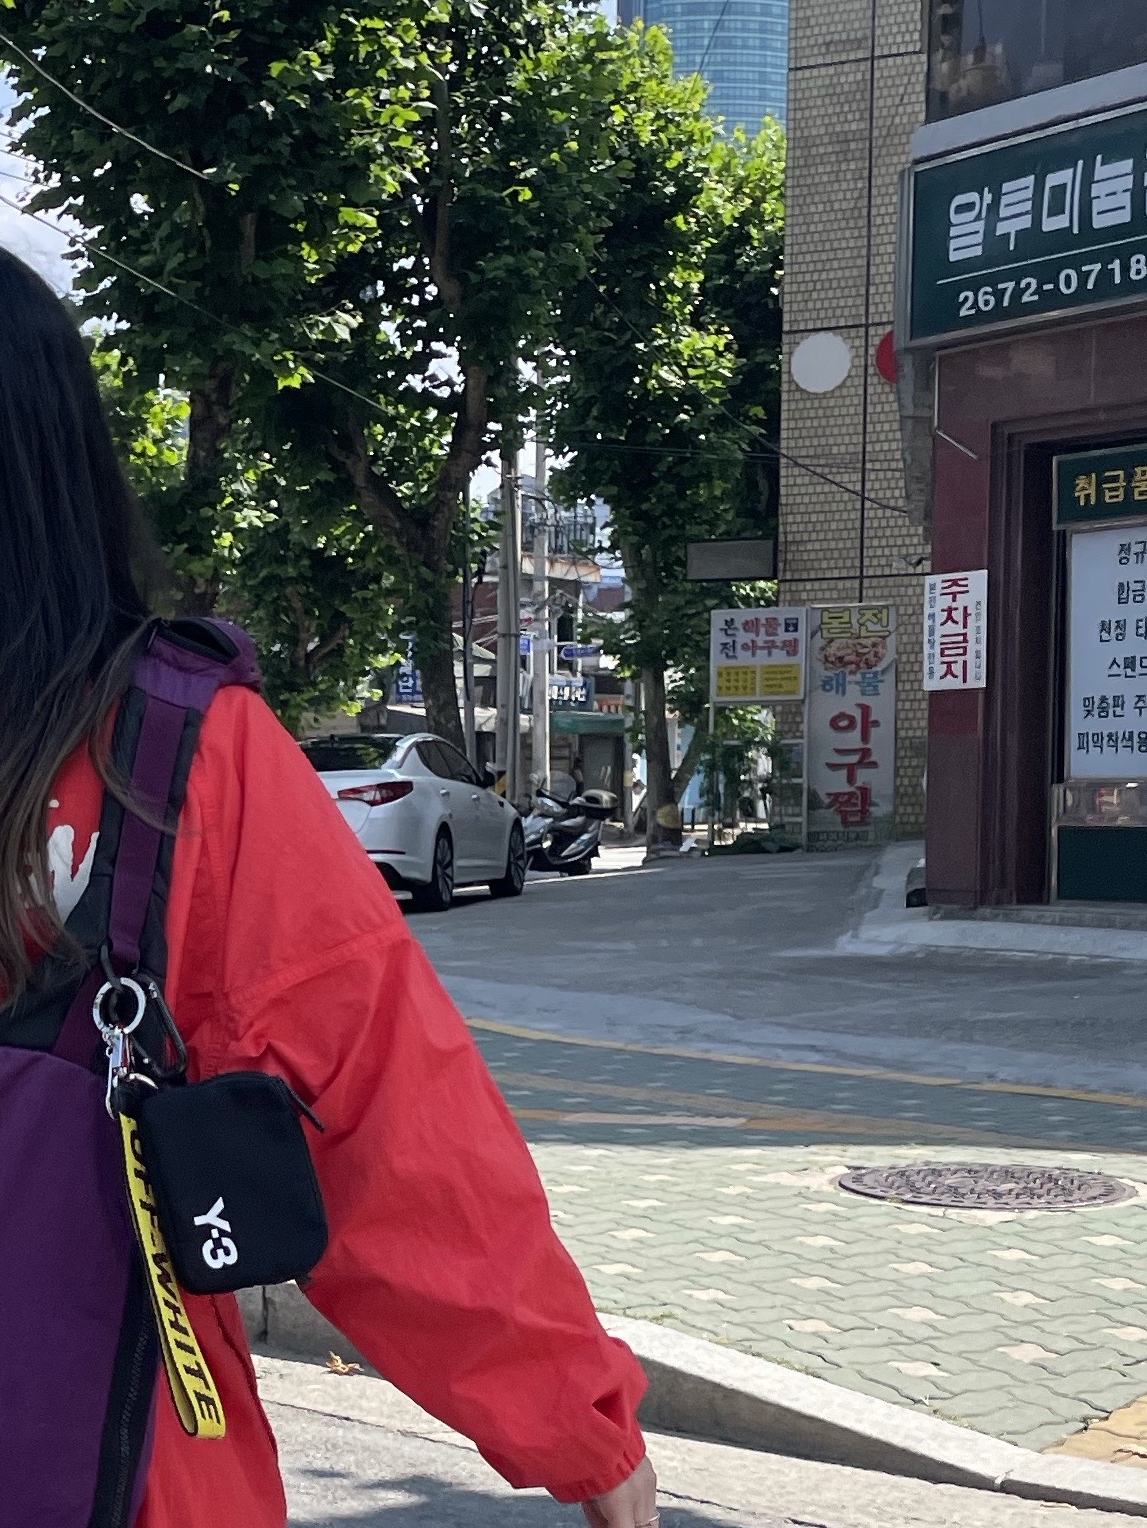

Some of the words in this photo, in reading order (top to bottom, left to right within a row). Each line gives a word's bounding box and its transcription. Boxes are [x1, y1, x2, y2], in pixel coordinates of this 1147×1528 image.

[948, 154, 1147, 262] 알루미늄
[958, 254, 1147, 317] 2672-0718
[820, 607, 891, 639] 본전
[940, 577, 972, 684] 주차금지
[821, 670, 884, 696] 해물
[824, 703, 881, 828] 아구찜
[193, 1196, 238, 1270] Y-3
